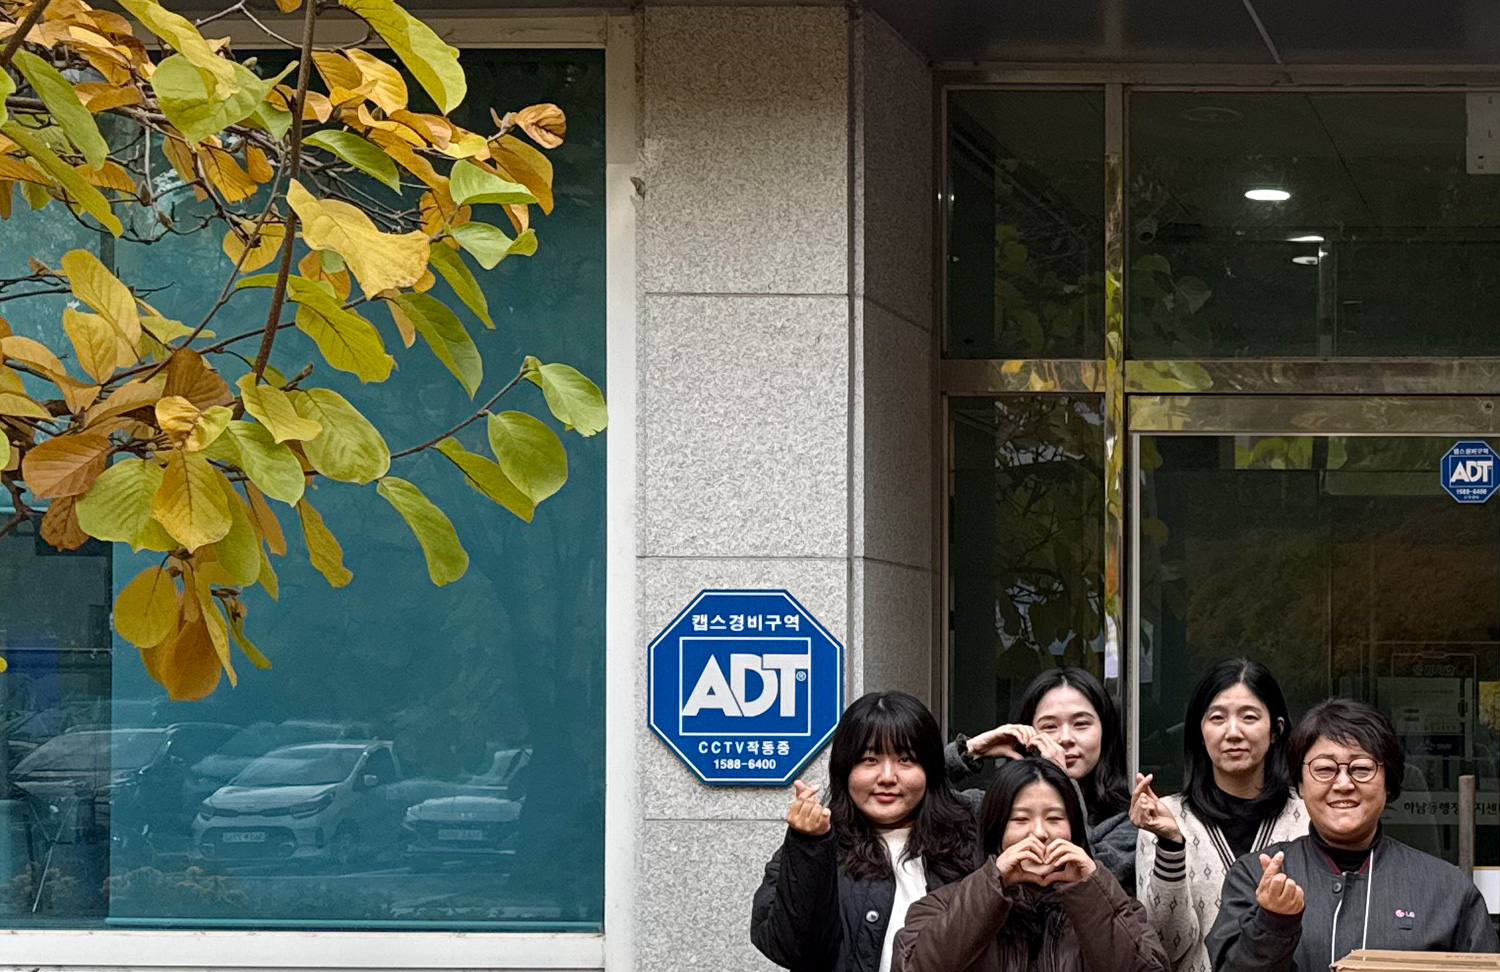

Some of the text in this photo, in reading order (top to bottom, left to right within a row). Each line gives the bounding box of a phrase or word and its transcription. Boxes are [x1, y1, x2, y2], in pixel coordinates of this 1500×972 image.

[1450, 461, 1493, 483] ADT
[692, 614, 800, 632] 캡스경비구역
[682, 654, 808, 717] ADT
[698, 740, 790, 756] CCTV작동중
[713, 758, 776, 770] 1588-6400
